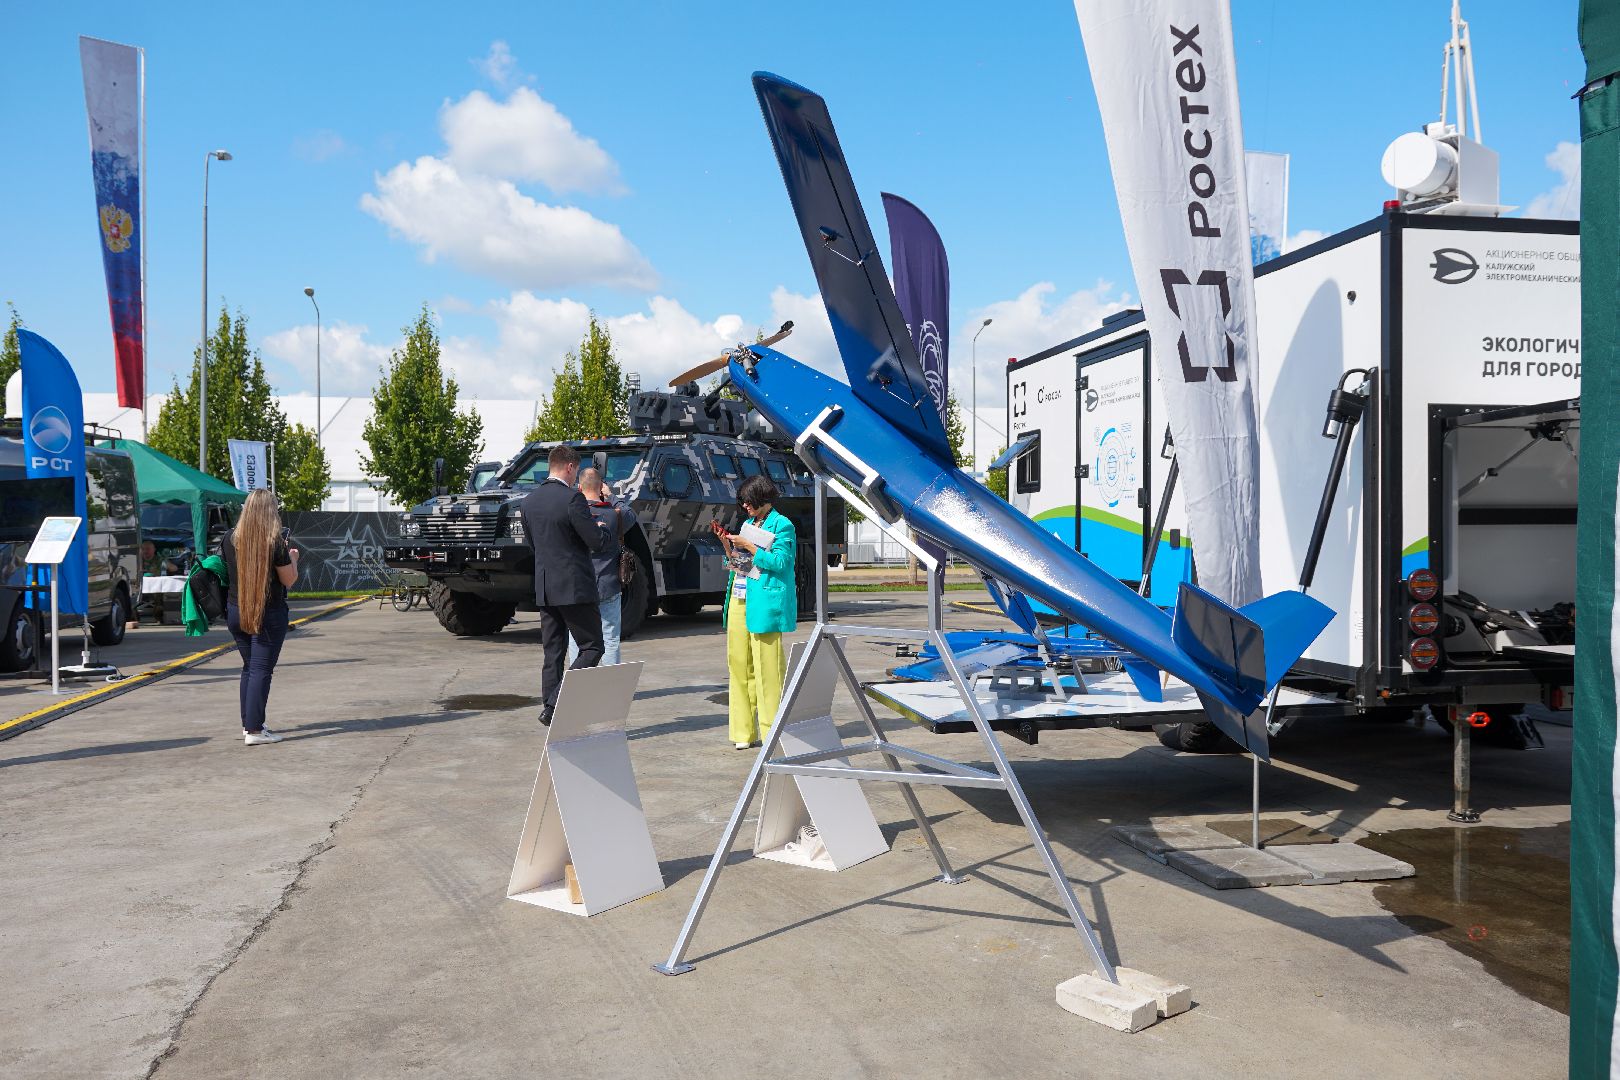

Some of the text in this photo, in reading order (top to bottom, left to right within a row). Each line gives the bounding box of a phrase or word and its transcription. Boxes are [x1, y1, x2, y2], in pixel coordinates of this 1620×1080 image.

[1169, 23, 1222, 238] Ростех
[1485, 250, 1580, 262] АКЦИОНЕРНОЕ ОБЩ
[1485, 262, 1535, 271] КАЛУЖСКИЙ
[1485, 273, 1581, 283] ЭЛЕКТРОМЕХАНИЧЕСКИ
[1482, 337, 1579, 354] ЭКОЛОГИЧ
[1482, 361, 1521, 378] ДЛЯ
[246, 454, 256, 492] НФОРЕЗ
